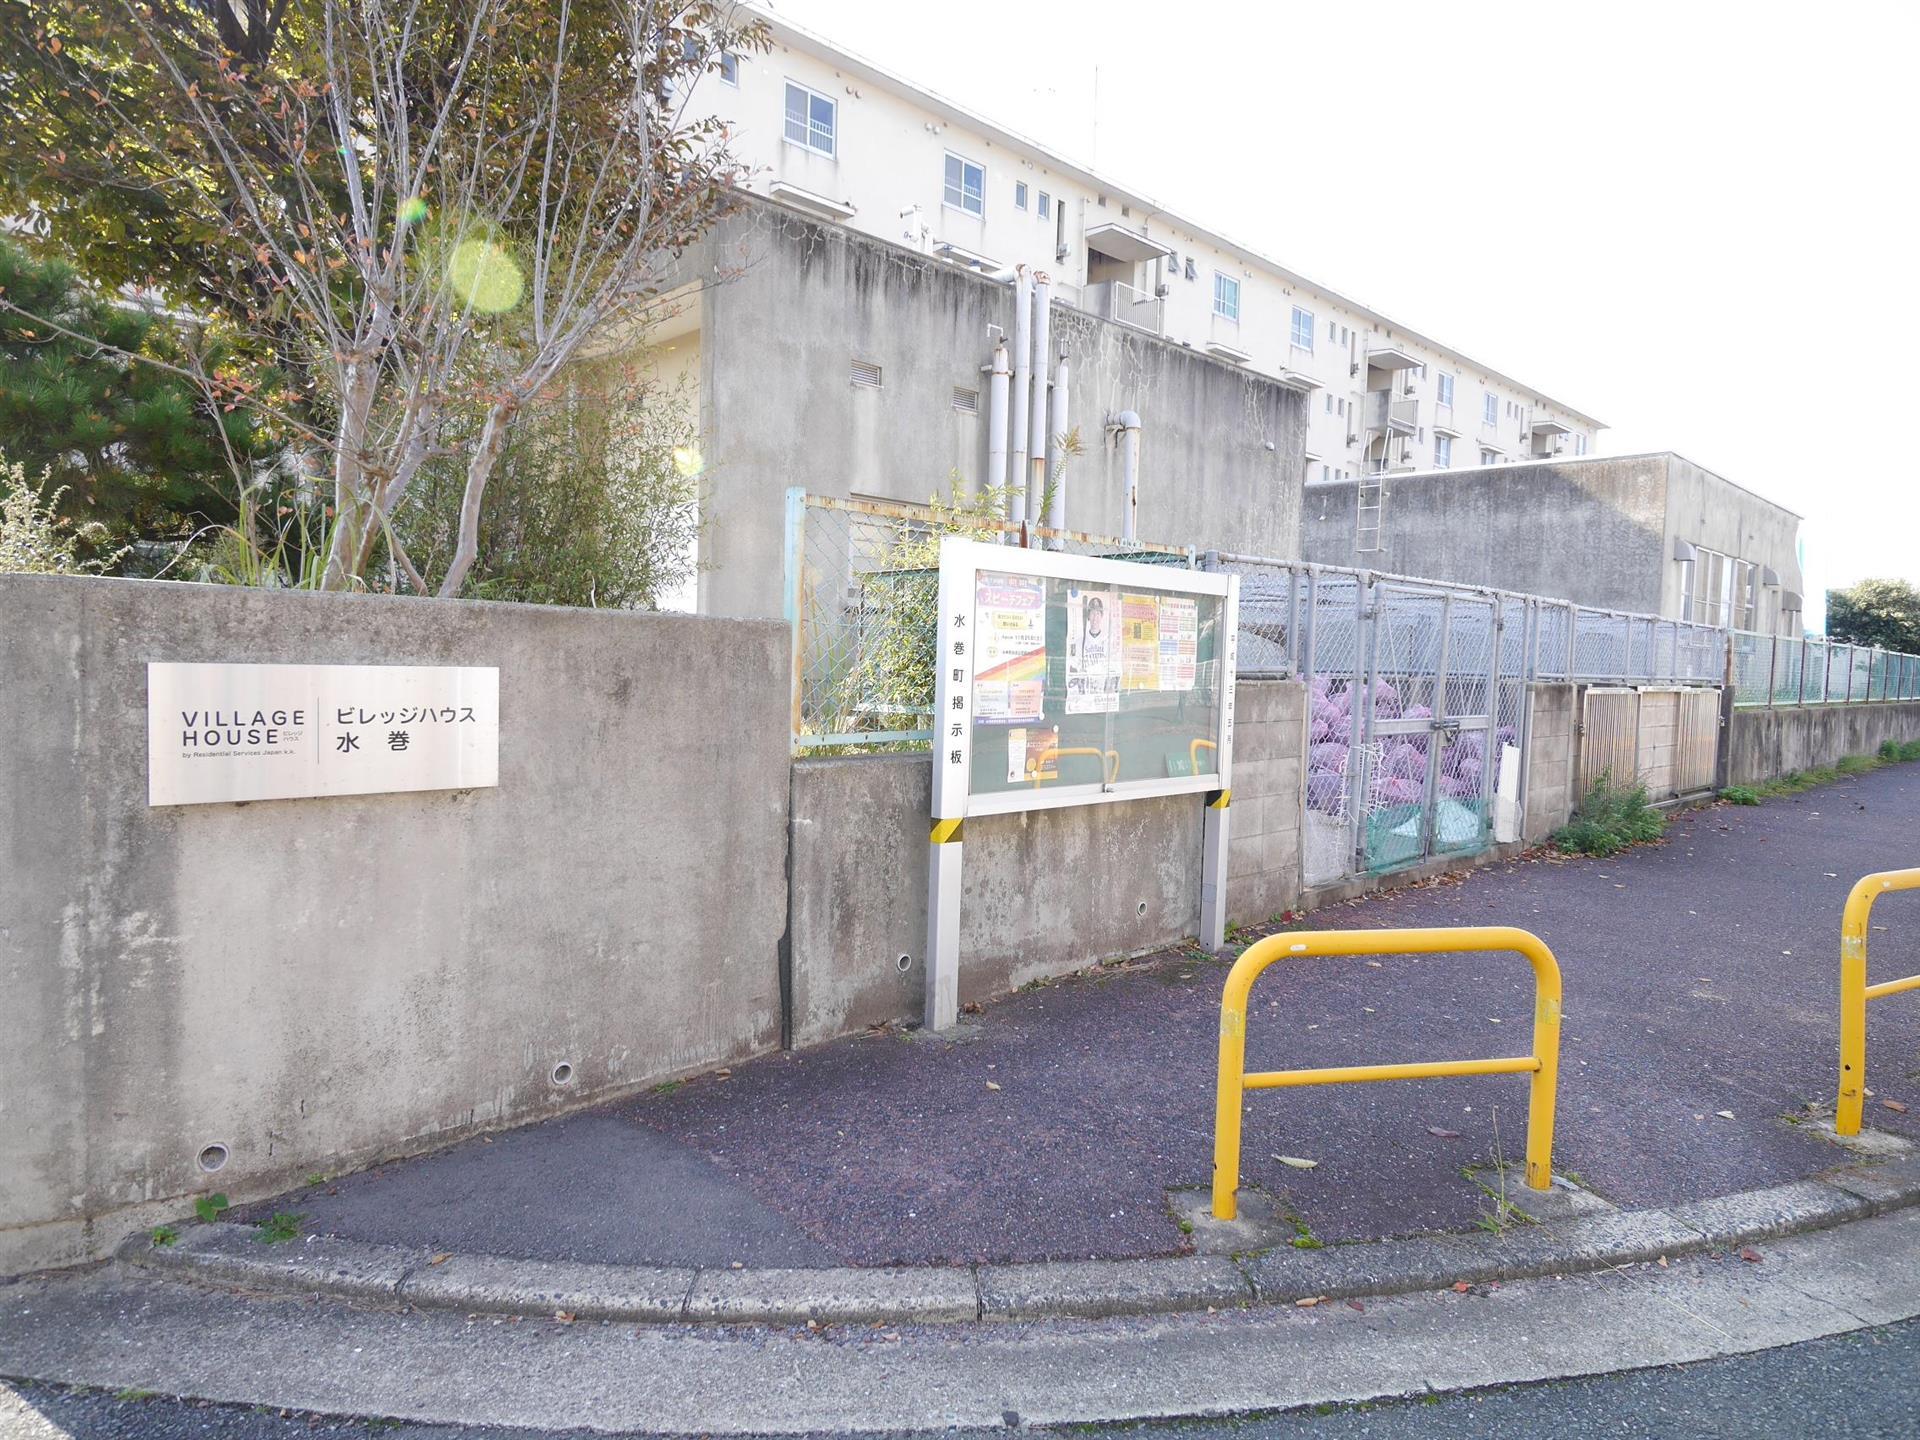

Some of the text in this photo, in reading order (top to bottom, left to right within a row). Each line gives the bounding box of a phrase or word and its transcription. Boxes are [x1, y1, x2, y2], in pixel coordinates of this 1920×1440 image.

[950, 614, 966, 765] 水巻町掲示板
[182, 710, 305, 727] VILLAGE
[337, 706, 477, 725] ビレッジハウス
[183, 729, 278, 747] HOUSE
[193, 750, 232, 758] Residential
[262, 749, 282, 757] Japan
